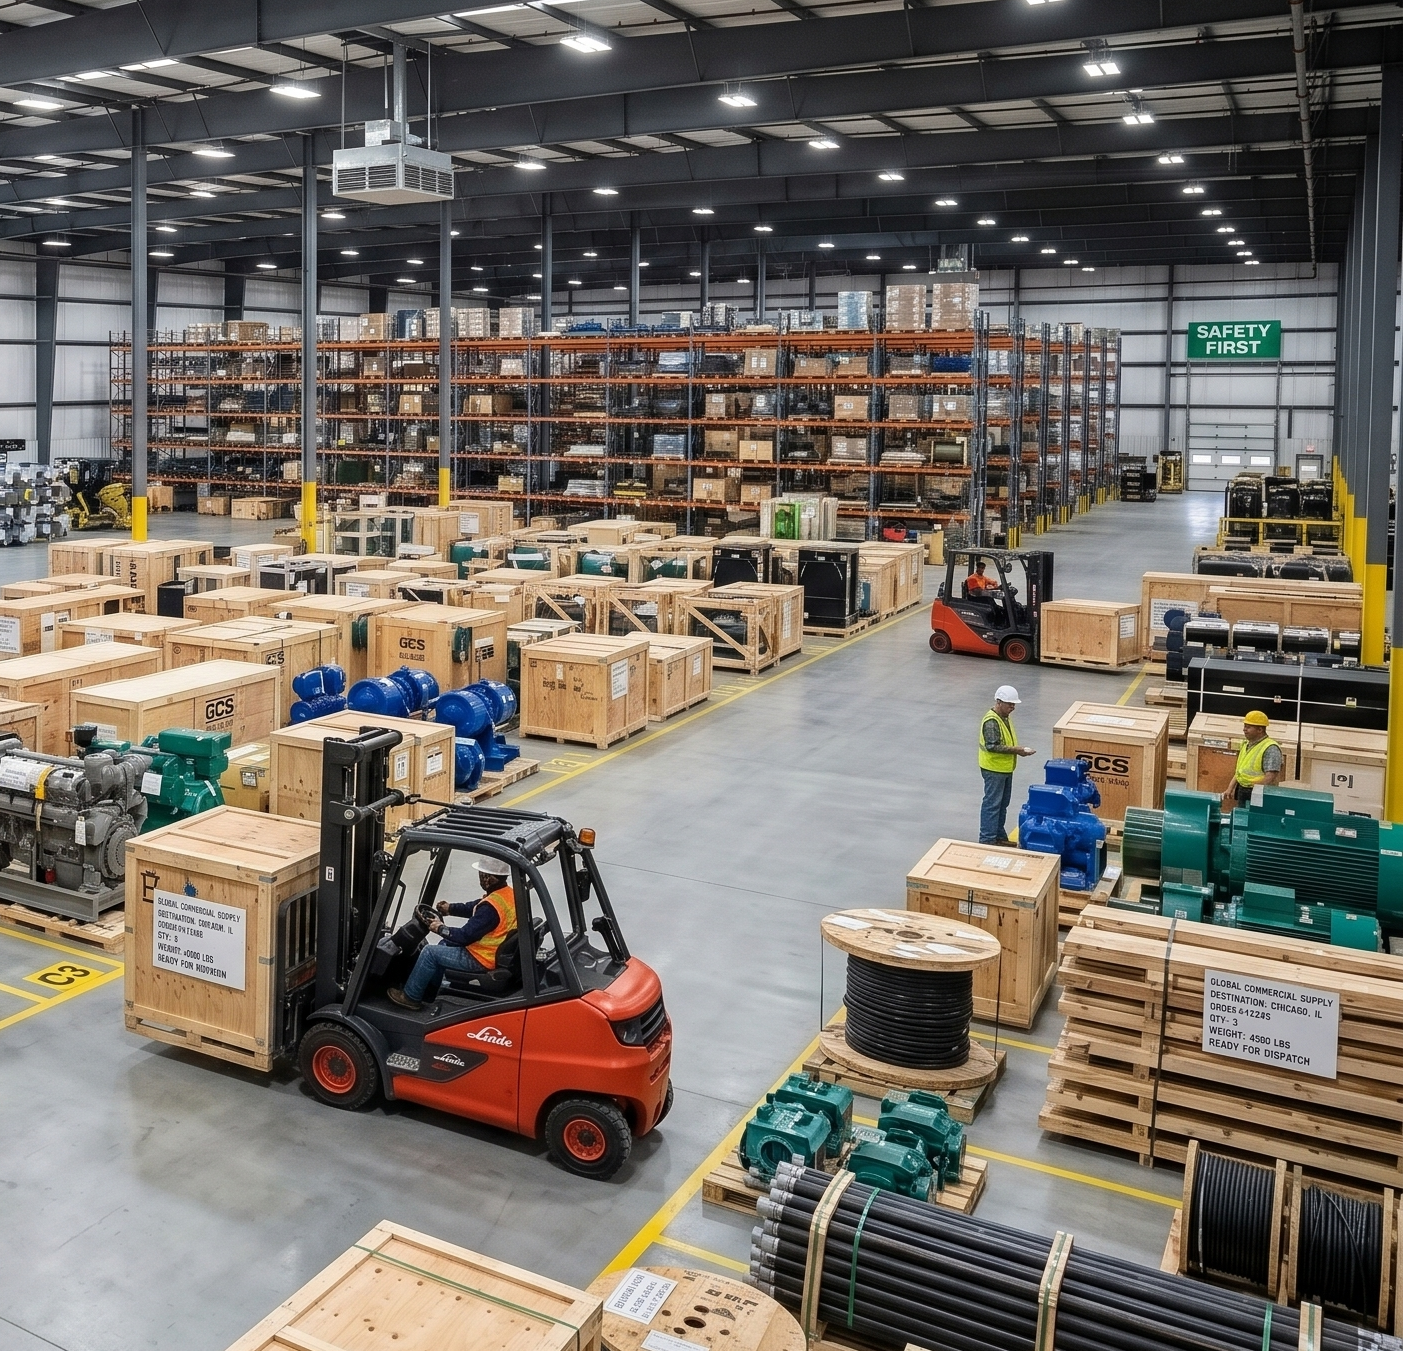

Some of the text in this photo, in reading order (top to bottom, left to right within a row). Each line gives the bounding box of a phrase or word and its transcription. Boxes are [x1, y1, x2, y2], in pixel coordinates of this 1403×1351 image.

[1197, 324, 1271, 339] SAFETY
[1205, 341, 1261, 354] FIRST
[205, 697, 234, 720] GCS
[202, 953, 214, 964] LBS
[37, 965, 91, 985] C3
[1210, 990, 1267, 1008] DESTINATION:
[1314, 1010, 1323, 1019] IL
[1300, 994, 1334, 1008] SUPPLY
[1232, 1018, 1239, 1026] 3
[466, 1026, 513, 1048] Linde
[1209, 1025, 1246, 1040] WEIGHT:
[1273, 1038, 1291, 1050] LBS
[1209, 1037, 1311, 1066] READY FOR DISPATCH
